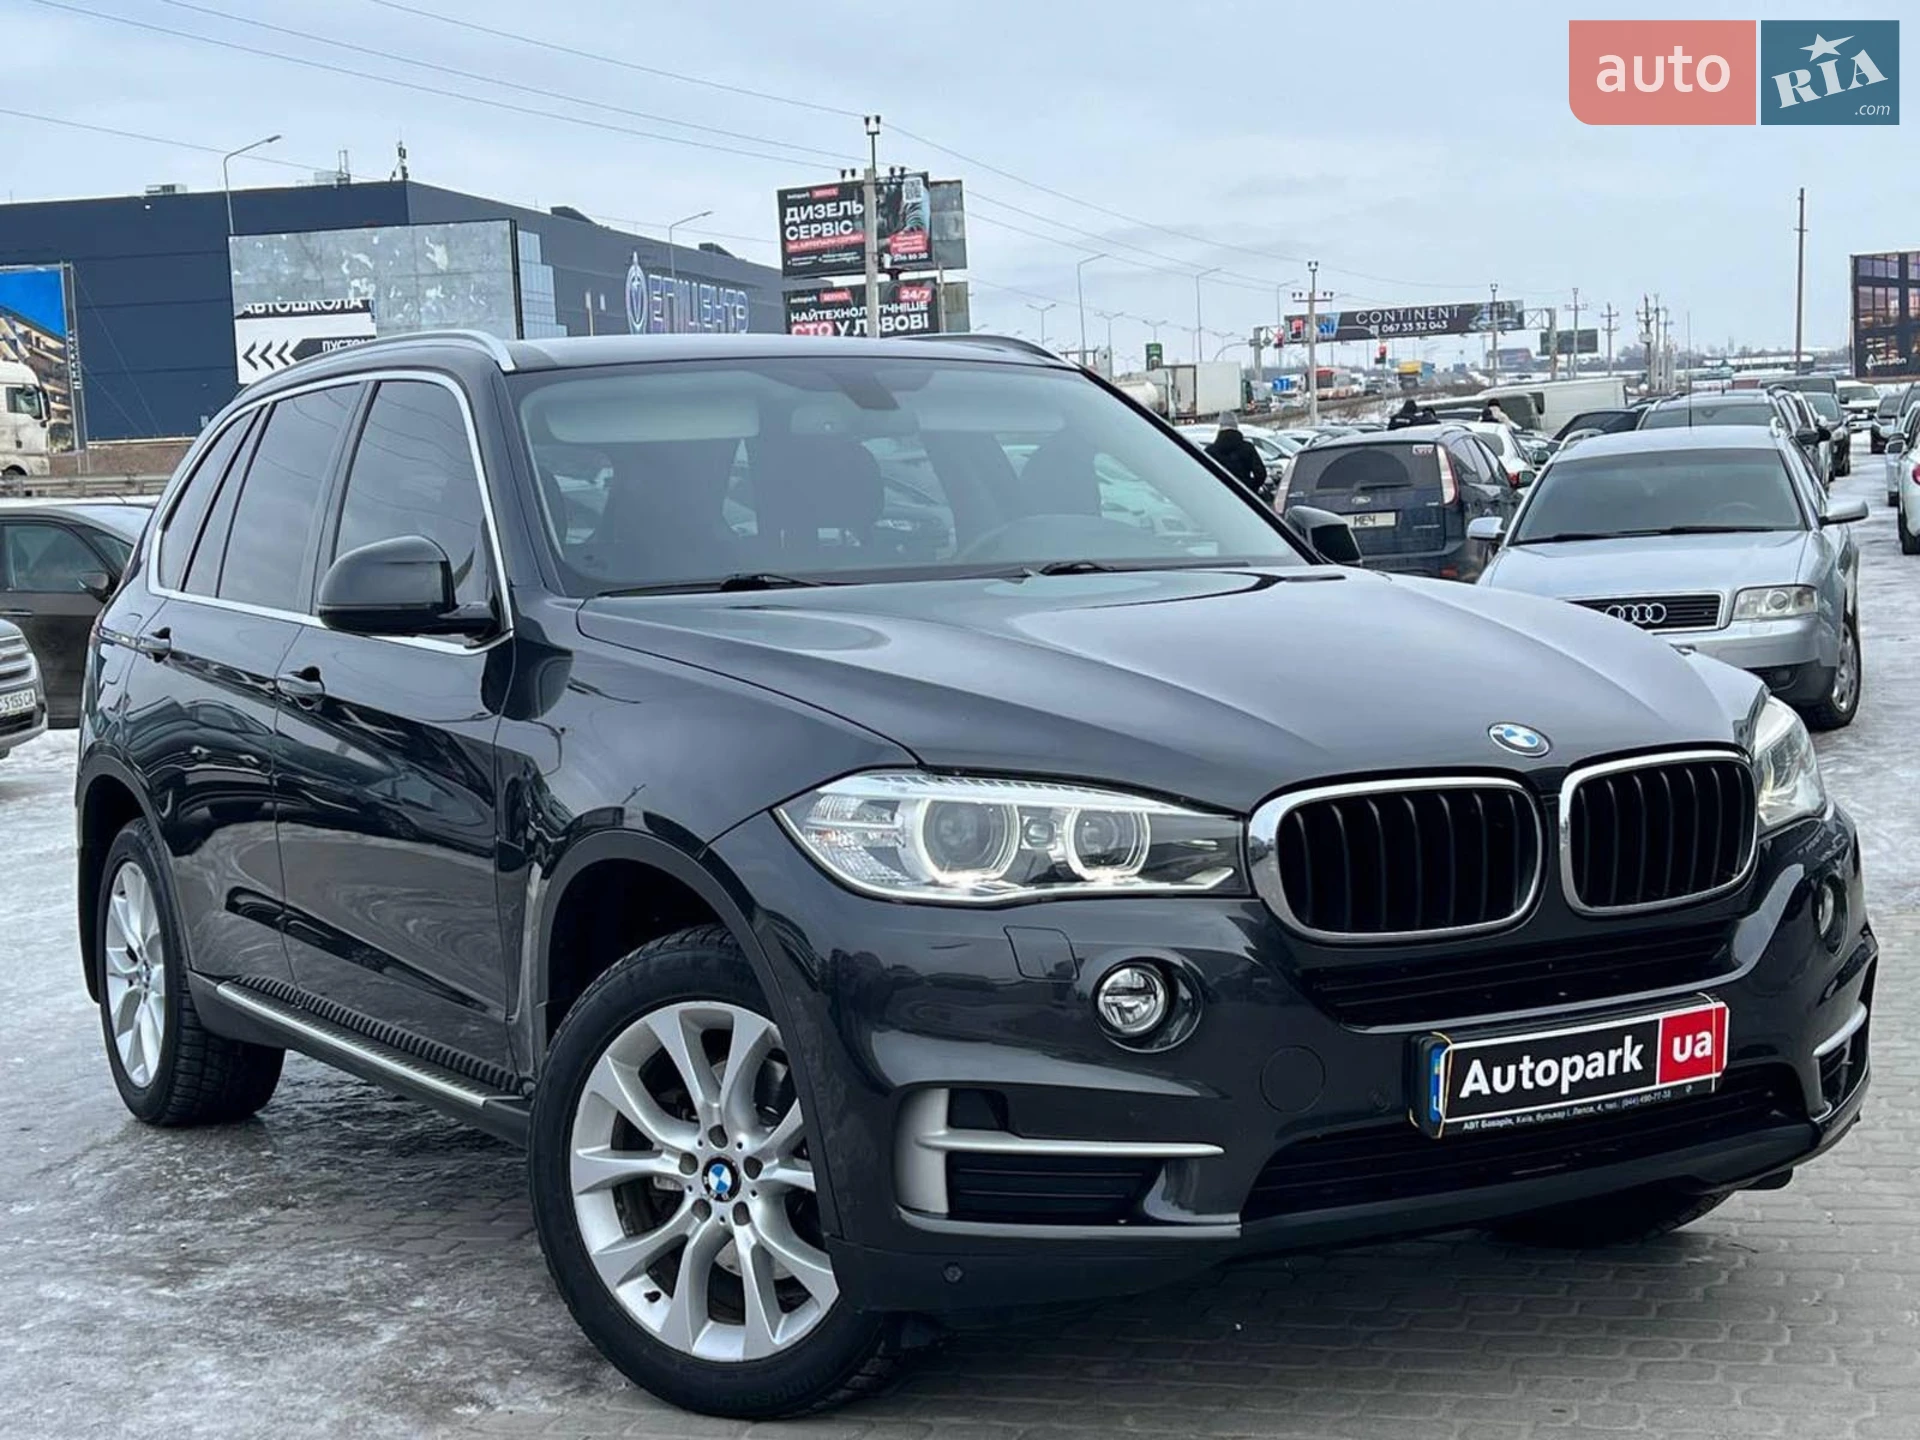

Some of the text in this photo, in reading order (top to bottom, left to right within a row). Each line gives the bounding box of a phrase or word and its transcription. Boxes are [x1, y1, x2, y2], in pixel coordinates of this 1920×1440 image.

[784, 199, 865, 225] ДИЗЕЛЬ
[785, 219, 854, 241] СЕРВІС
[836, 319, 849, 336] У
[852, 313, 929, 336] ЛВОВІ
[1355, 305, 1460, 325] CONTINENT
[1459, 1030, 1713, 1099] Autopark ua
